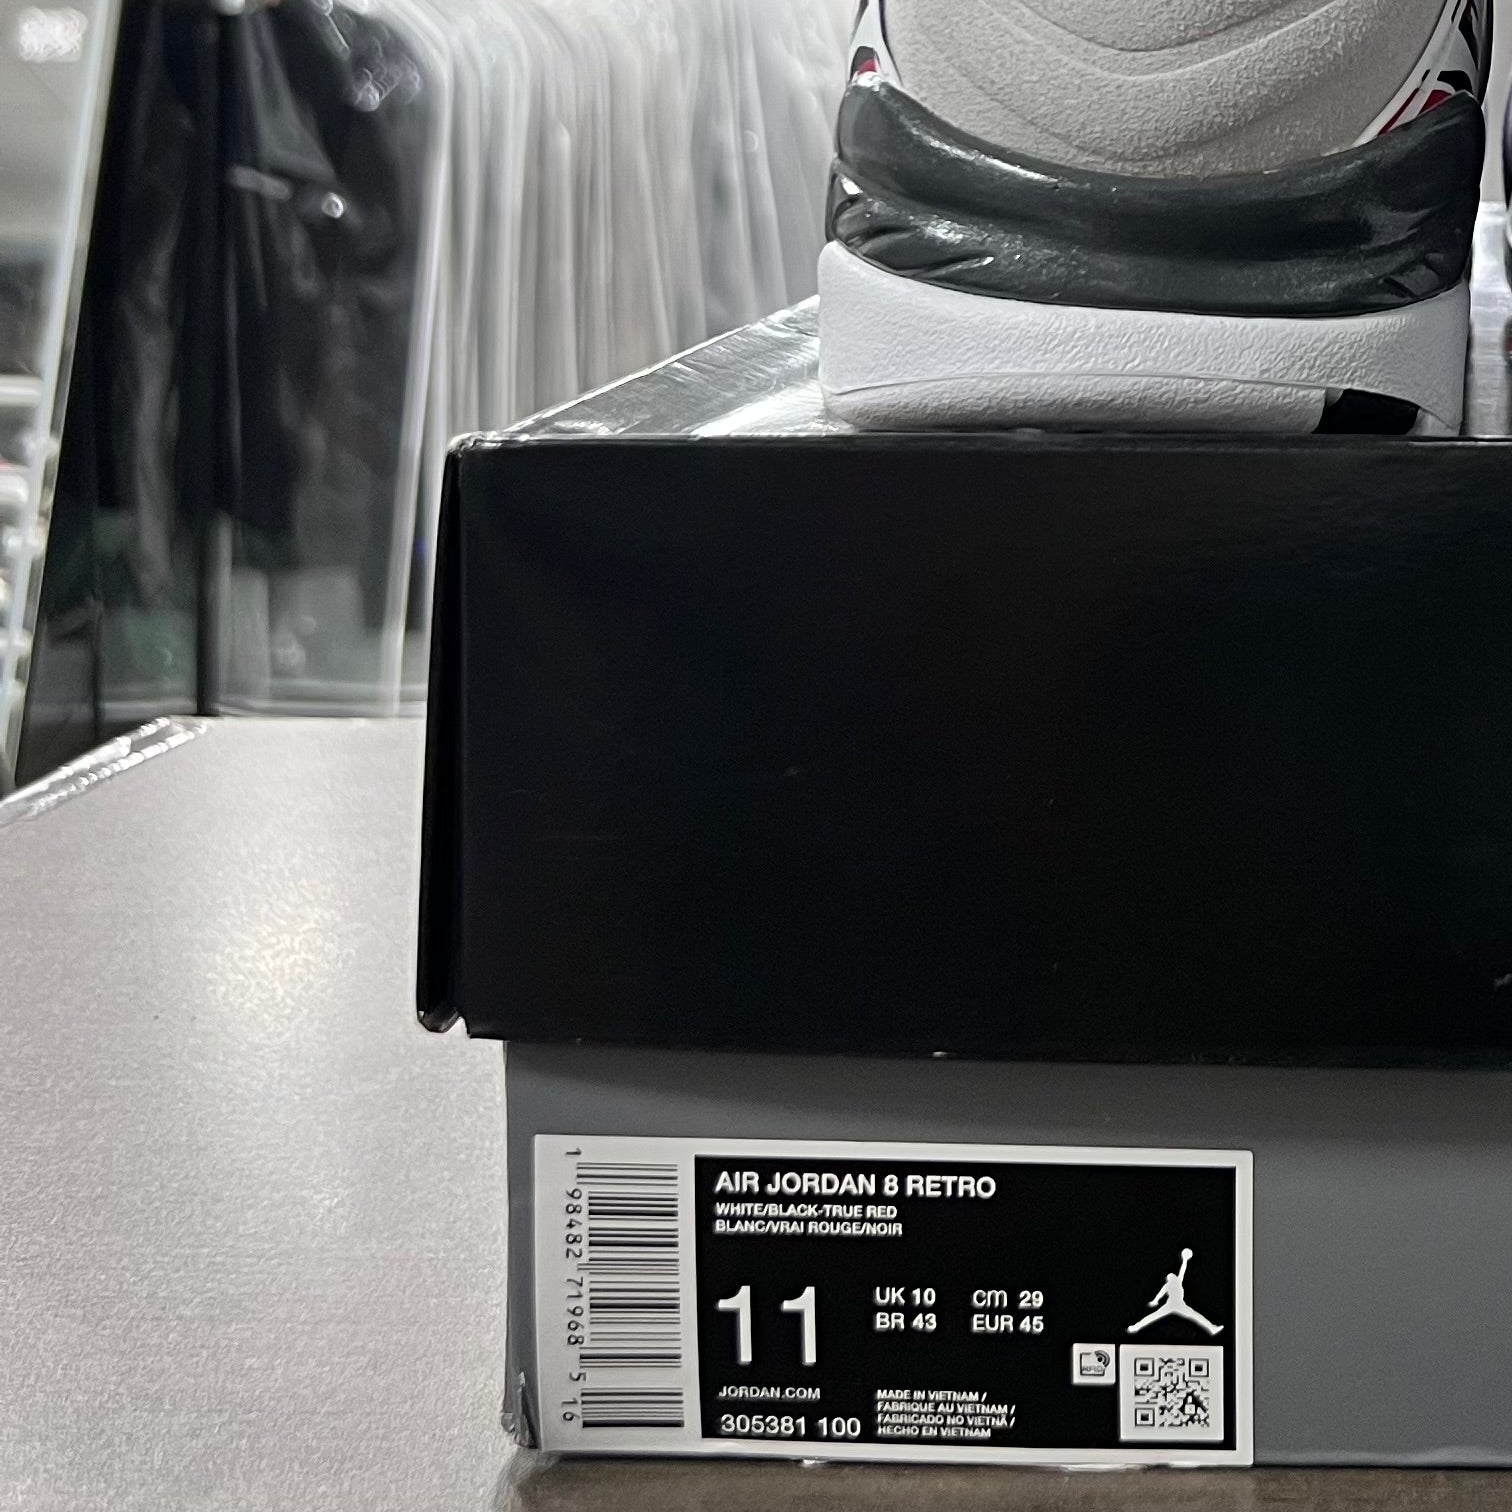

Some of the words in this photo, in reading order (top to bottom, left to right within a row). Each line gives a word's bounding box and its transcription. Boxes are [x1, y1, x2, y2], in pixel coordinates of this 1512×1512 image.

[714, 1171, 760, 1194] AIR
[766, 1172, 876, 1196] JORDAN
[883, 1174, 899, 1196] 8
[905, 1175, 997, 1198] RETRO
[714, 1202, 863, 1218] WHITE/BLACK-TRUE
[866, 1205, 898, 1219] RED
[713, 1219, 804, 1234] BLANC/VRAI
[807, 1221, 903, 1236] ROUGE/NOIR
[874, 1286, 905, 1304] UK
[911, 1287, 936, 1305] 10
[1018, 1290, 1044, 1308] 29
[717, 1285, 816, 1364] 11
[874, 1312, 905, 1330] BR
[911, 1313, 937, 1331] 43
[972, 1314, 1014, 1333] EUR
[1018, 1315, 1044, 1334] 45
[718, 1386, 821, 1400] JORDAN.COM
[877, 1389, 911, 1400] MADE
[913, 1390, 926, 1400] IN
[928, 1390, 979, 1402] VIETNAM
[877, 1401, 935, 1412] FABRIQUE
[937, 1402, 955, 1413] AU
[956, 1403, 1008, 1414] VIETNAM
[720, 1414, 806, 1435] 305381
[816, 1416, 861, 1437] 100
[877, 1413, 944, 1424] FABRICADO
[946, 1415, 965, 1426] NO
[878, 1425, 919, 1436] HECHO
[921, 1426, 938, 1437] EN
[940, 1427, 991, 1438] VIETNAM
